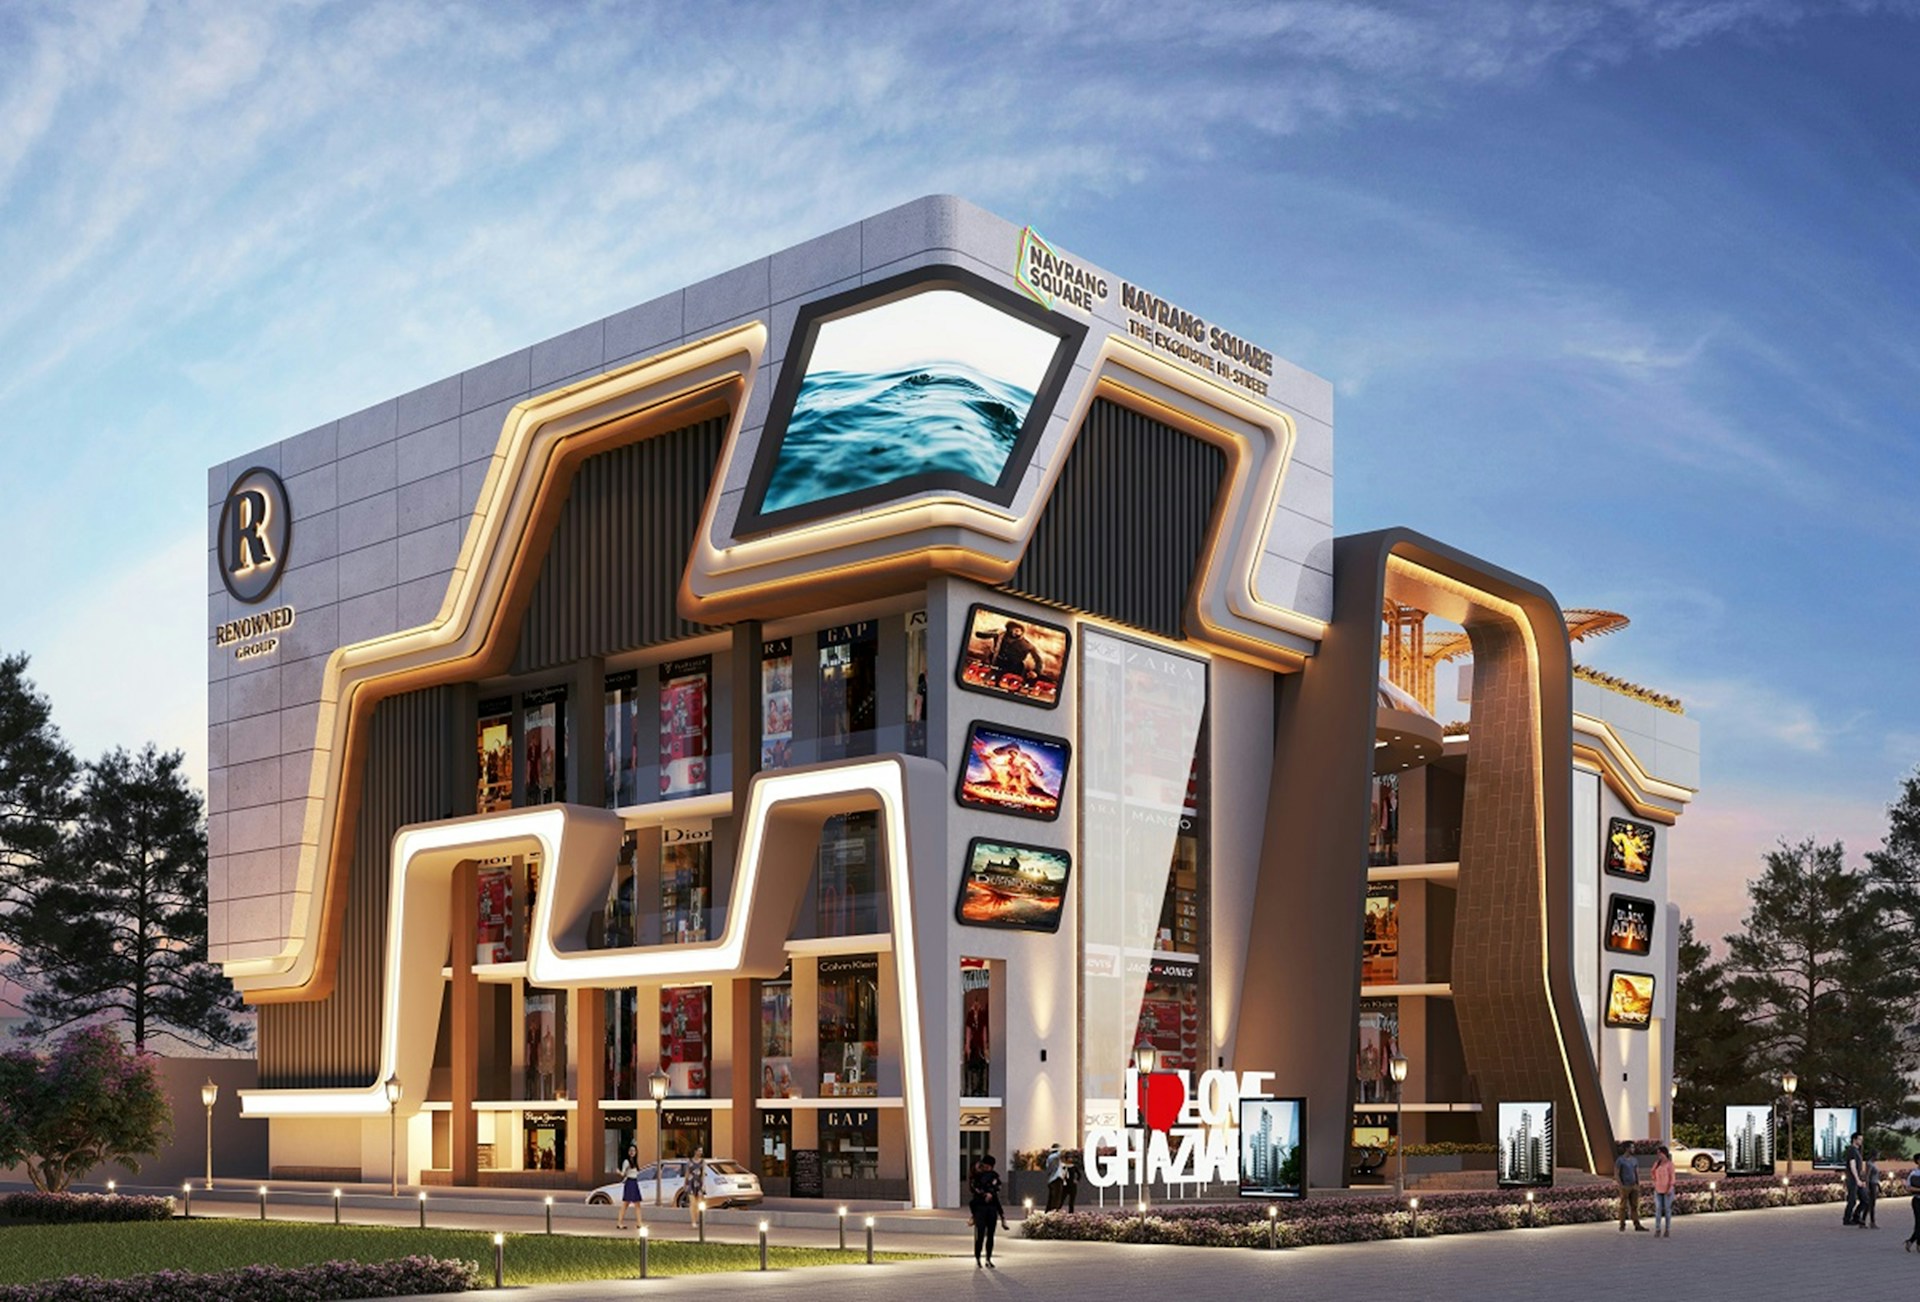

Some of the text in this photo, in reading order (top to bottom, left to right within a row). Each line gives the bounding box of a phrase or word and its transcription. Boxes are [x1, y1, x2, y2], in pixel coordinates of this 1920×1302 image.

[1029, 245, 1108, 299] NAVRANG
[1029, 267, 1092, 312] SQUARE
[1121, 282, 1273, 377] NAVRANG SQUARE
[1128, 318, 1152, 342] THE
[1216, 360, 1268, 397] HI-STREET
[228, 489, 274, 574] R
[215, 606, 293, 645] RENOWNED
[827, 622, 868, 643] GAP
[235, 639, 277, 659] GROUP
[1127, 652, 1195, 681] ZARA
[1131, 810, 1192, 830] MANGO
[664, 828, 713, 843] Dior
[1611, 918, 1649, 941] ADAM
[820, 957, 878, 973] Calvin Klein
[1127, 962, 1153, 974] JACK
[1162, 966, 1194, 979] JONES
[765, 1114, 788, 1125] RA
[829, 1112, 869, 1126] GAP
[1083, 1127, 1240, 1187] GHAZIA
